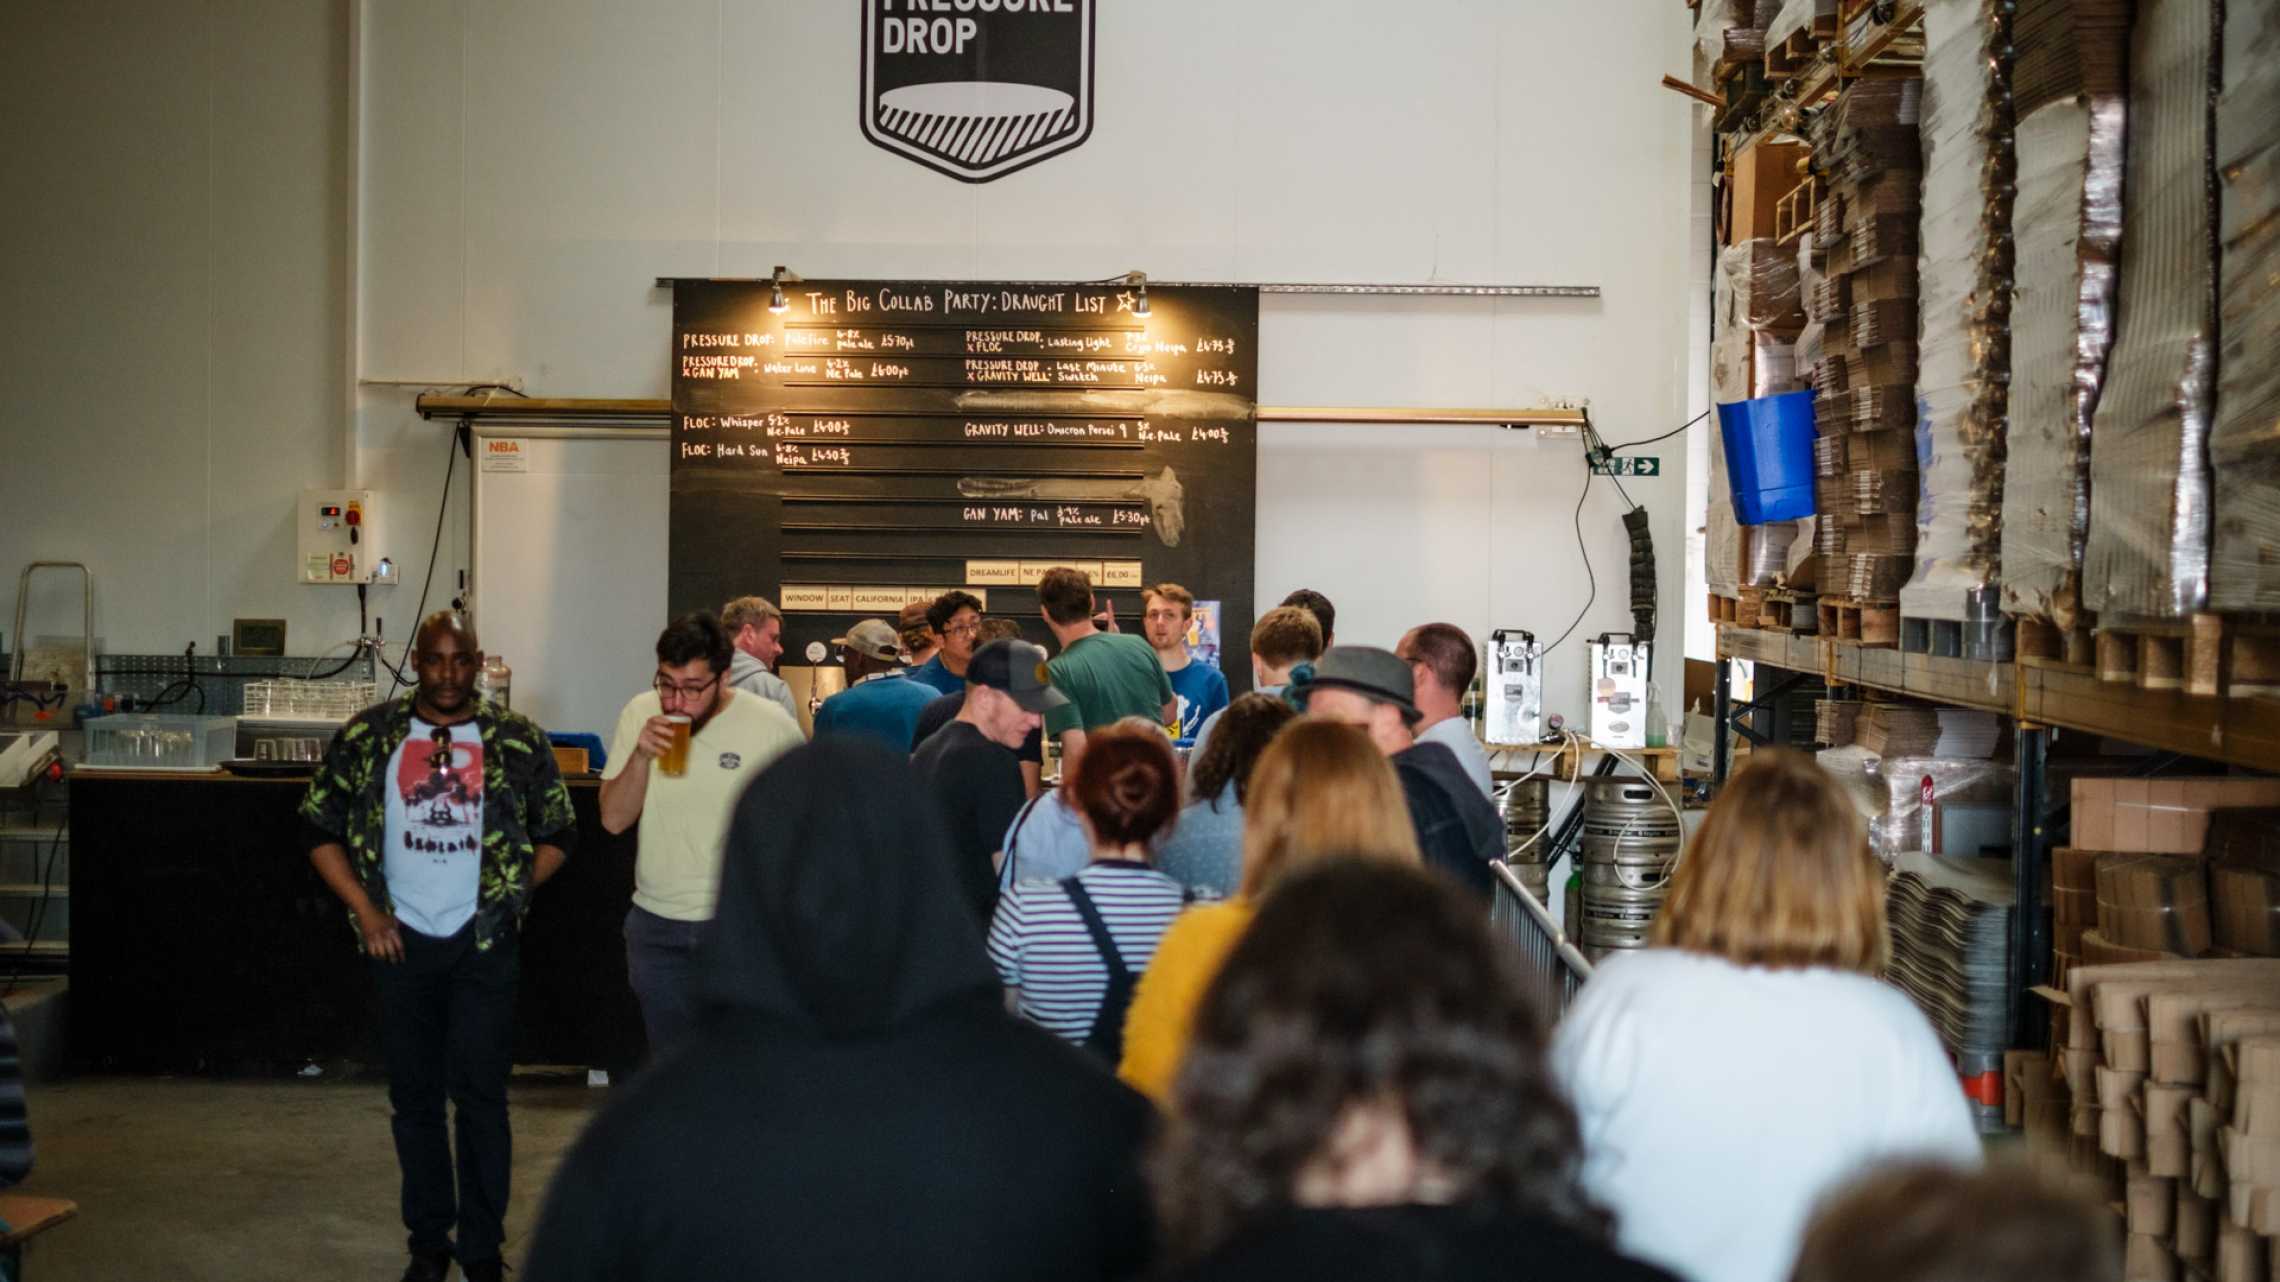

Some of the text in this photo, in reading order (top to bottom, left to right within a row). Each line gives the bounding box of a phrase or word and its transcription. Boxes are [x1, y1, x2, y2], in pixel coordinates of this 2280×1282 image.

[883, 17, 977, 54] DROP
[805, 292, 837, 315] THE
[846, 289, 871, 312] BIG
[879, 288, 933, 312] COLLAB
[1001, 291, 1064, 312] DRAUGHT
[1075, 292, 1106, 314] LIST
[683, 333, 740, 350] PRESSURE
[965, 331, 1015, 343] PRESSURE
[976, 342, 1002, 353] FLOC
[683, 355, 729, 368] PRESSURE
[965, 360, 1013, 371] PRESSURE
[1056, 362, 1080, 372] Last
[692, 367, 715, 379] GAN
[718, 367, 740, 380] YAM
[976, 371, 1019, 382] GRAVITY
[720, 415, 764, 429] Whisper
[964, 422, 1008, 437] GRAVITY
[488, 441, 521, 453] NBA
[716, 443, 744, 458] Hard
[749, 445, 769, 457] Sun
[963, 507, 986, 522] GAN
[969, 567, 1016, 577] DREAMLIFE
[785, 593, 824, 603] WINDOW
[830, 595, 849, 604] SEAT
[855, 595, 904, 604] CALIFORNIA
